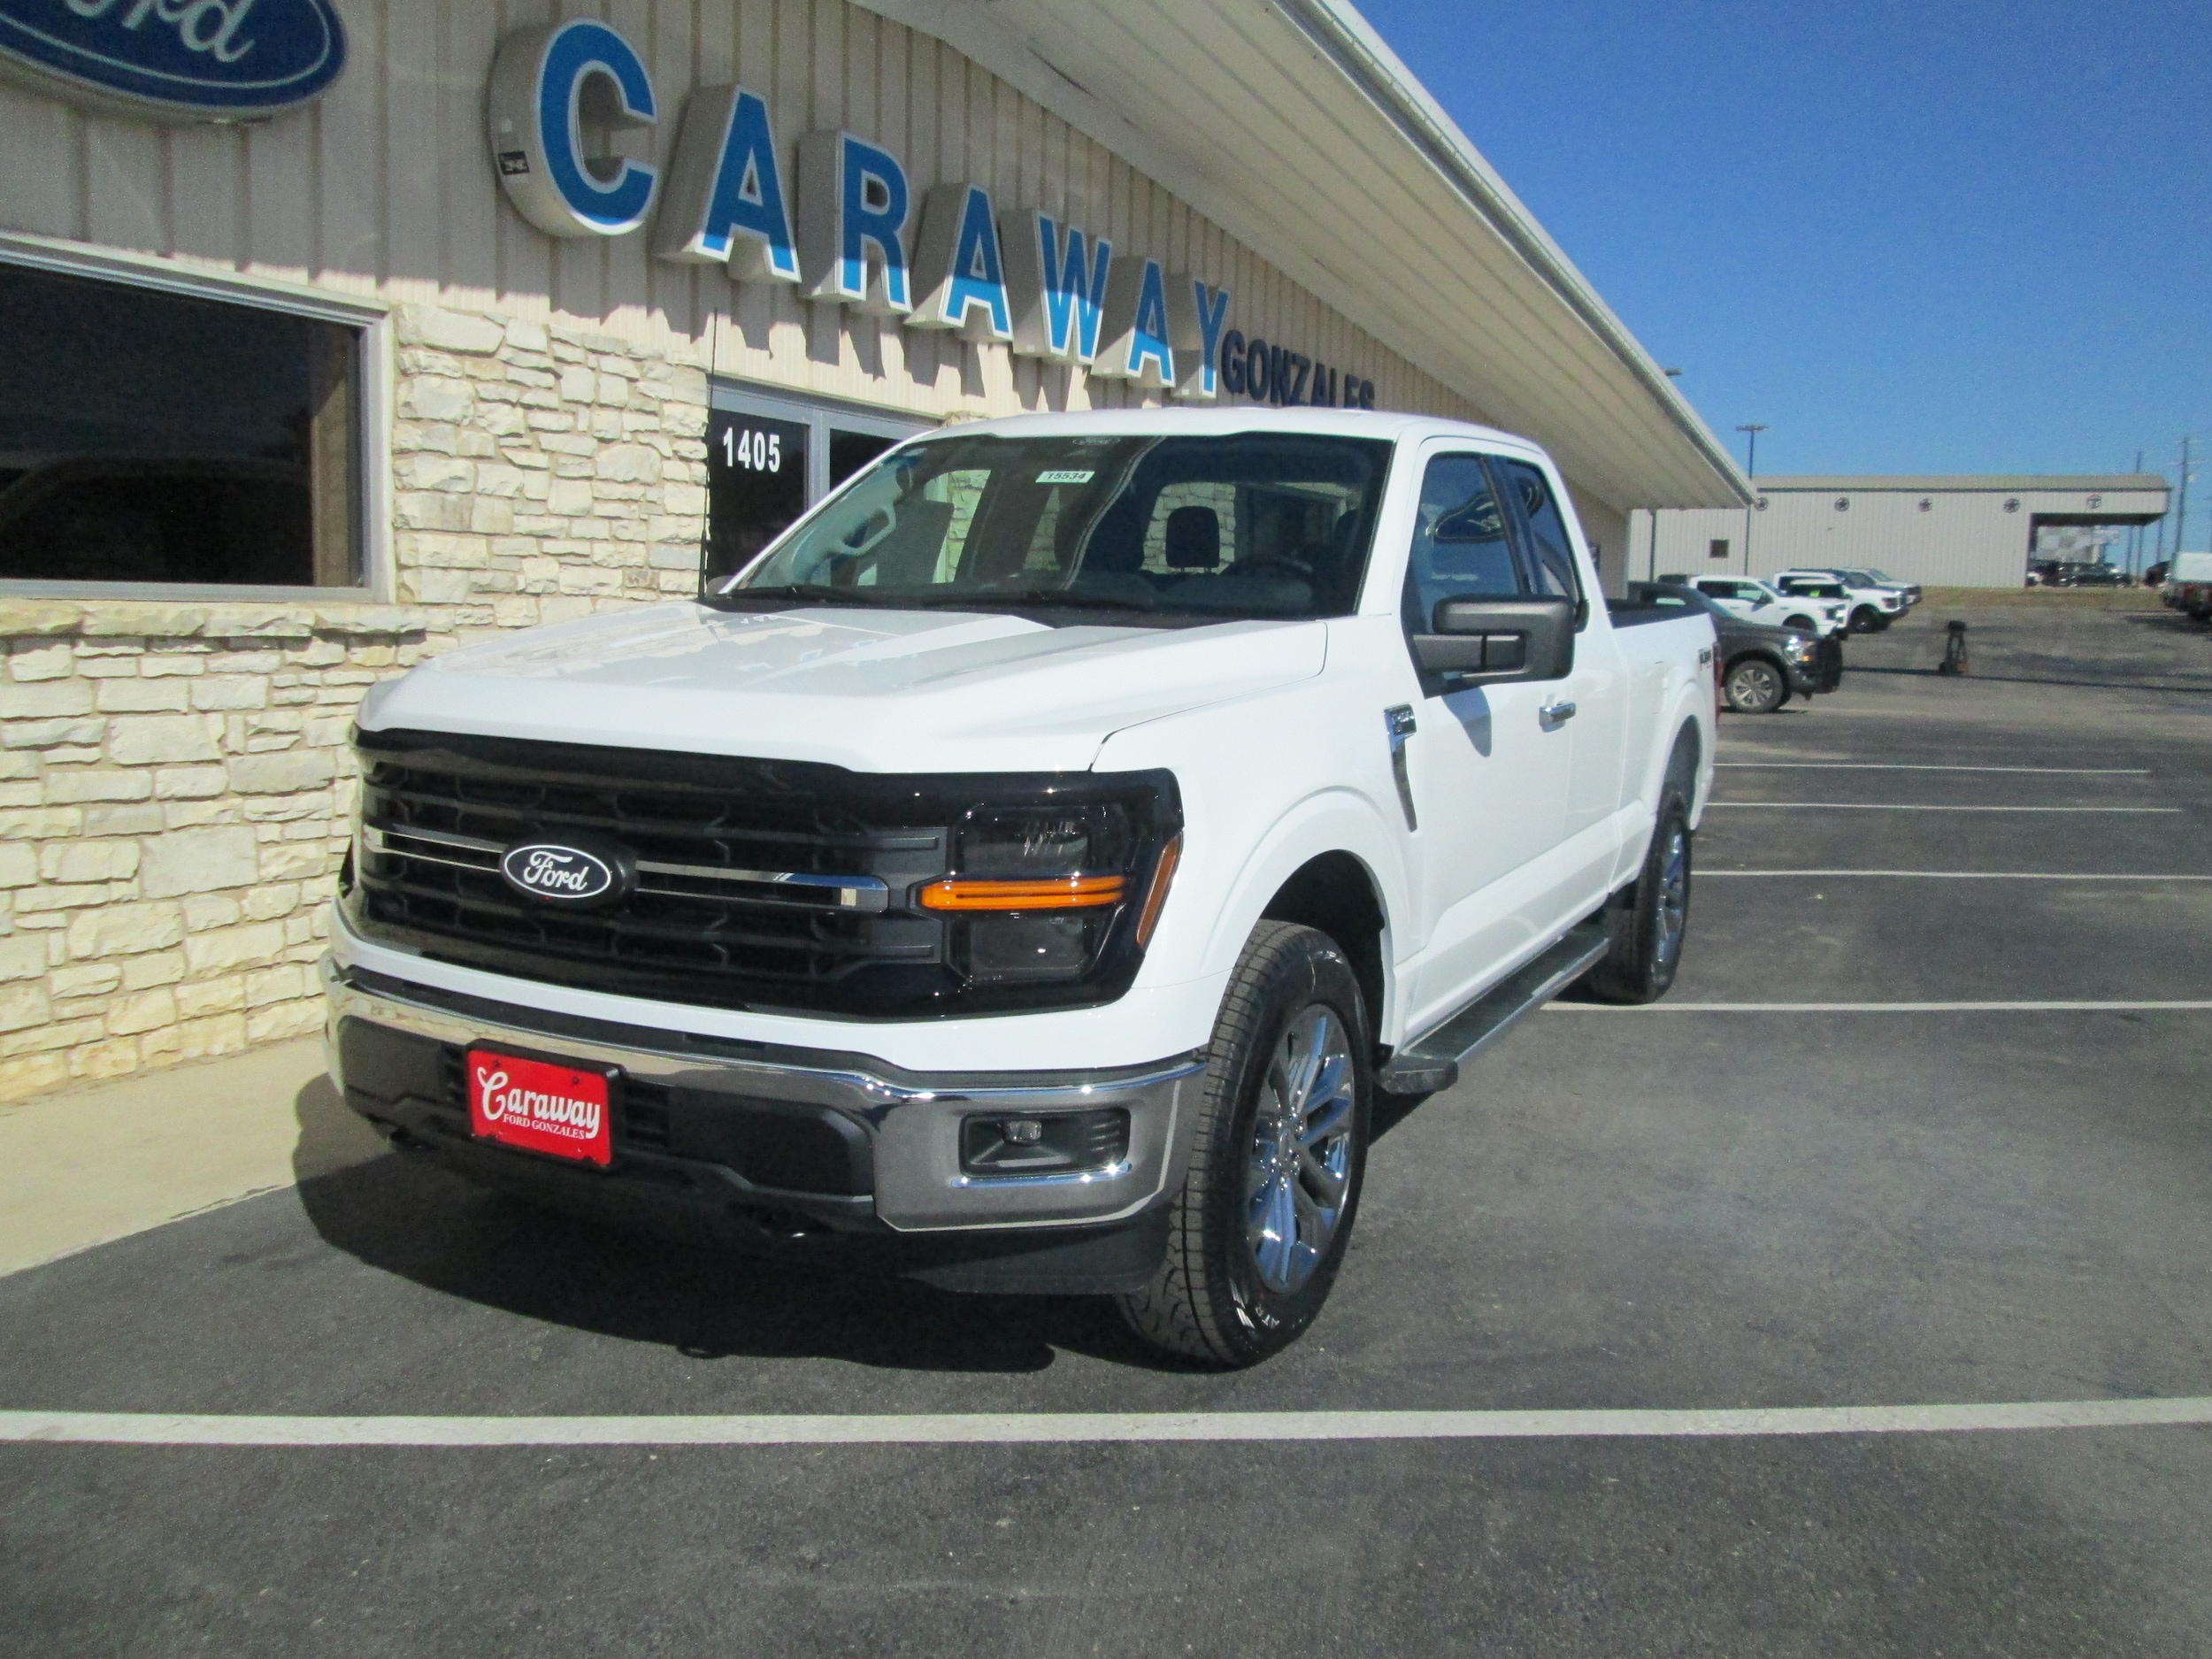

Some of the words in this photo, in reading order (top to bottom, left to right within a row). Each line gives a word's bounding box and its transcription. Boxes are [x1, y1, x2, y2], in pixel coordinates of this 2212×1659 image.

[536, 17, 1231, 399] CARAWAY
[1221, 329, 1375, 410] GONZALES
[723, 426, 780, 472] 1405
[523, 850, 589, 891] Ford
[477, 1066, 601, 1140] Caraway
[503, 1114, 531, 1128] FORD
[532, 1119, 585, 1140] GONZALES
